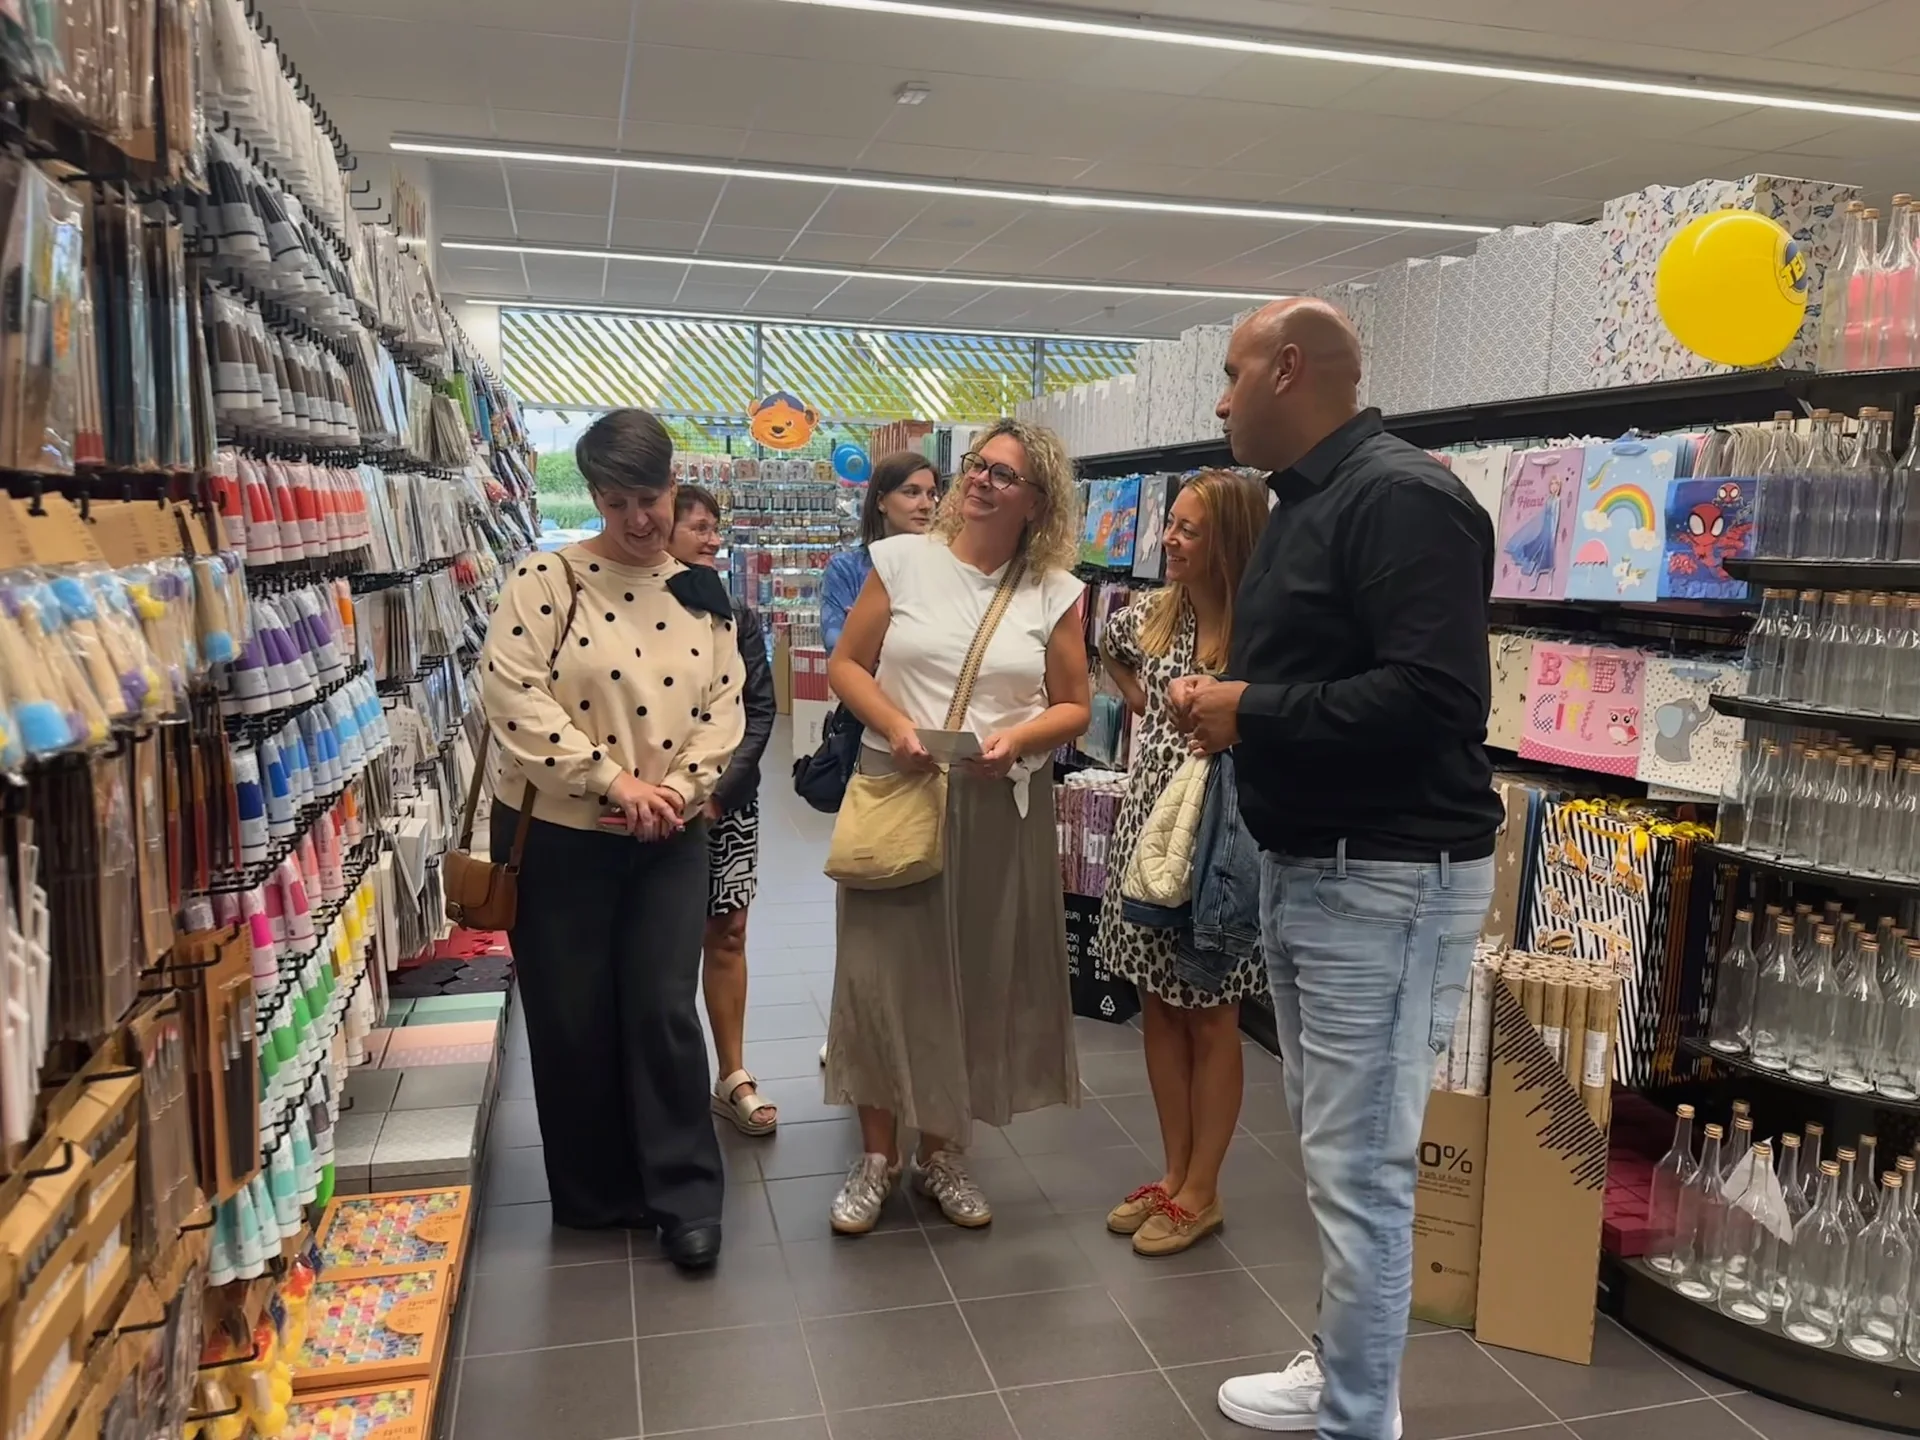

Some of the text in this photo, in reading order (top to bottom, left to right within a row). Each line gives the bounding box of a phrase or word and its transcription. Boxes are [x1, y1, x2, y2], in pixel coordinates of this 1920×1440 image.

[1779, 251, 1807, 288] TE
[1537, 652, 1645, 694] BABY
[1713, 737, 1729, 753] Boy
[1088, 914, 1100, 924] 1,5
[1095, 970, 1101, 980] 8
[1418, 1142, 1473, 1174] 0%
